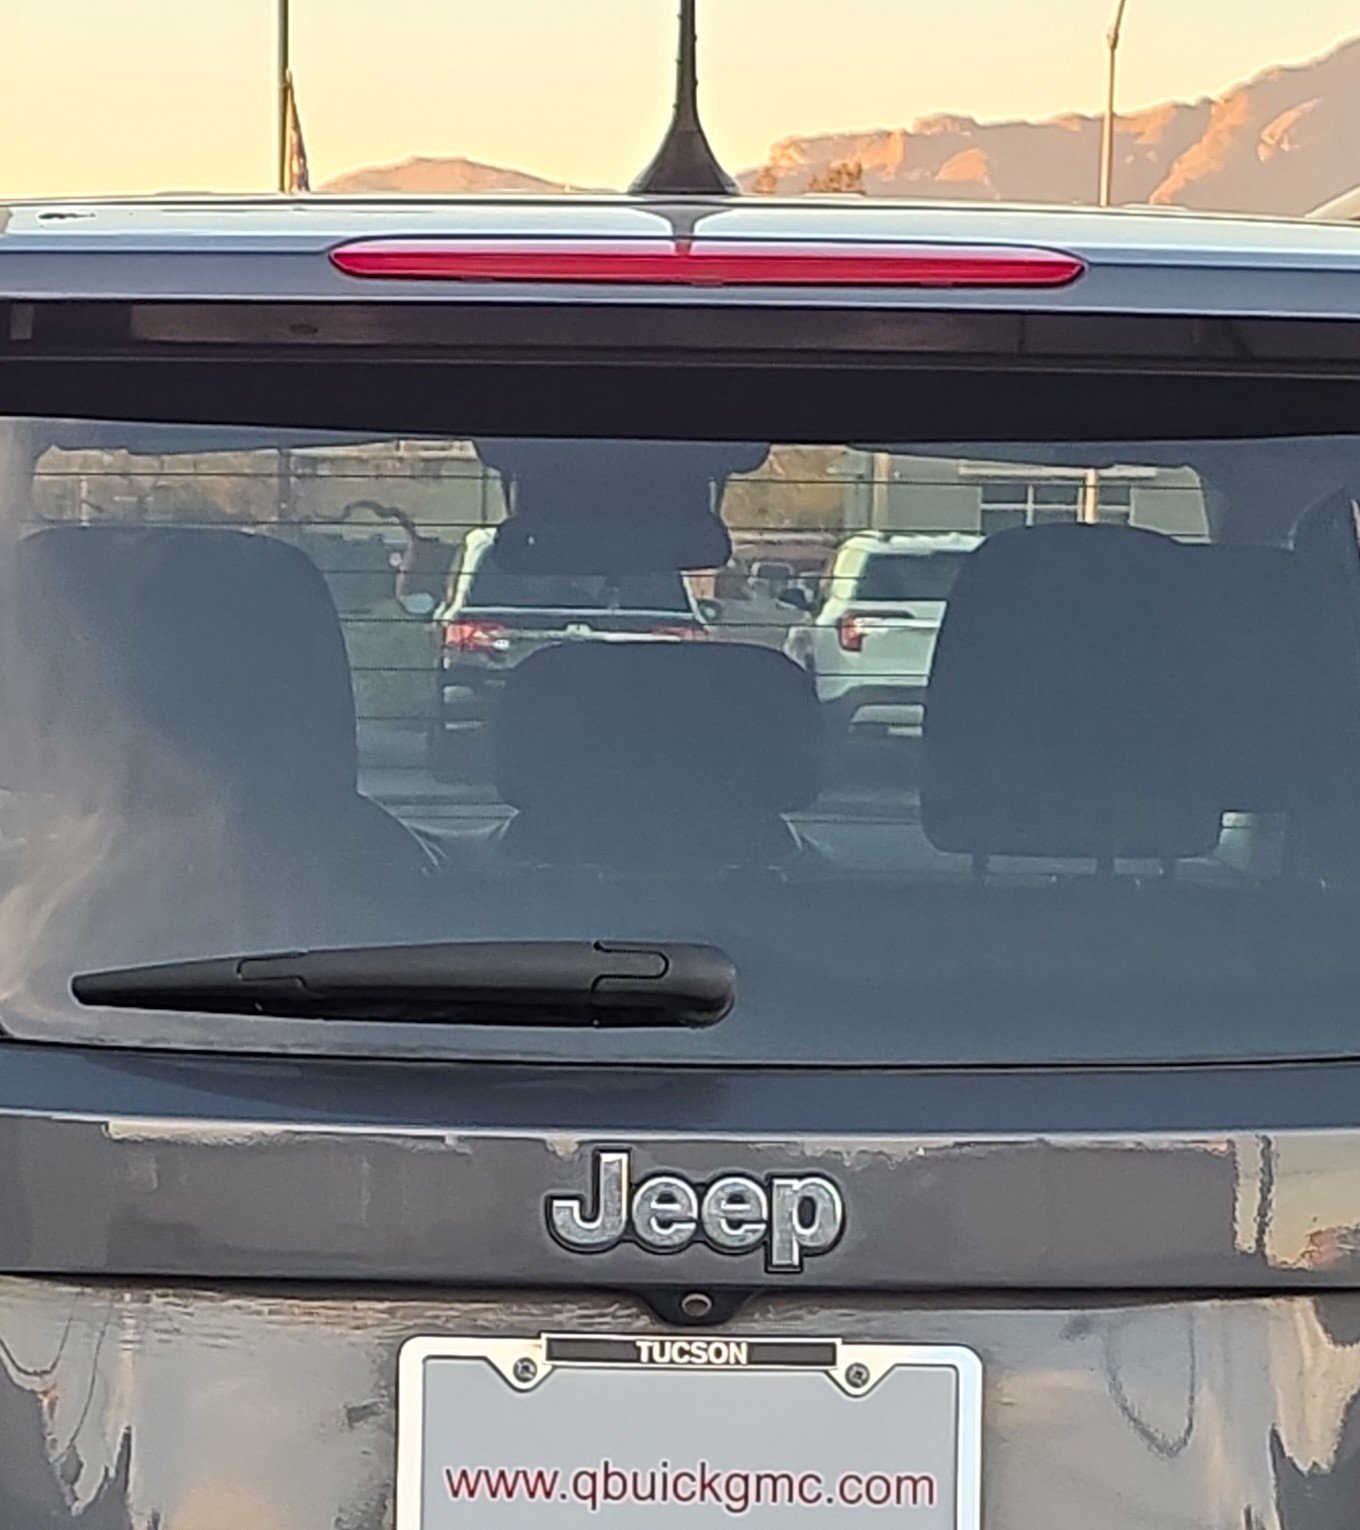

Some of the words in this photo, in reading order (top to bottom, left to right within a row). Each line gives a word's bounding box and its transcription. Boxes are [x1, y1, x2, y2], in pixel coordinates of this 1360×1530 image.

[544, 1149, 846, 1273] Jeep
[635, 1341, 748, 1365] TUCSON
[445, 1461, 935, 1512] www.qbuickgmc.com
